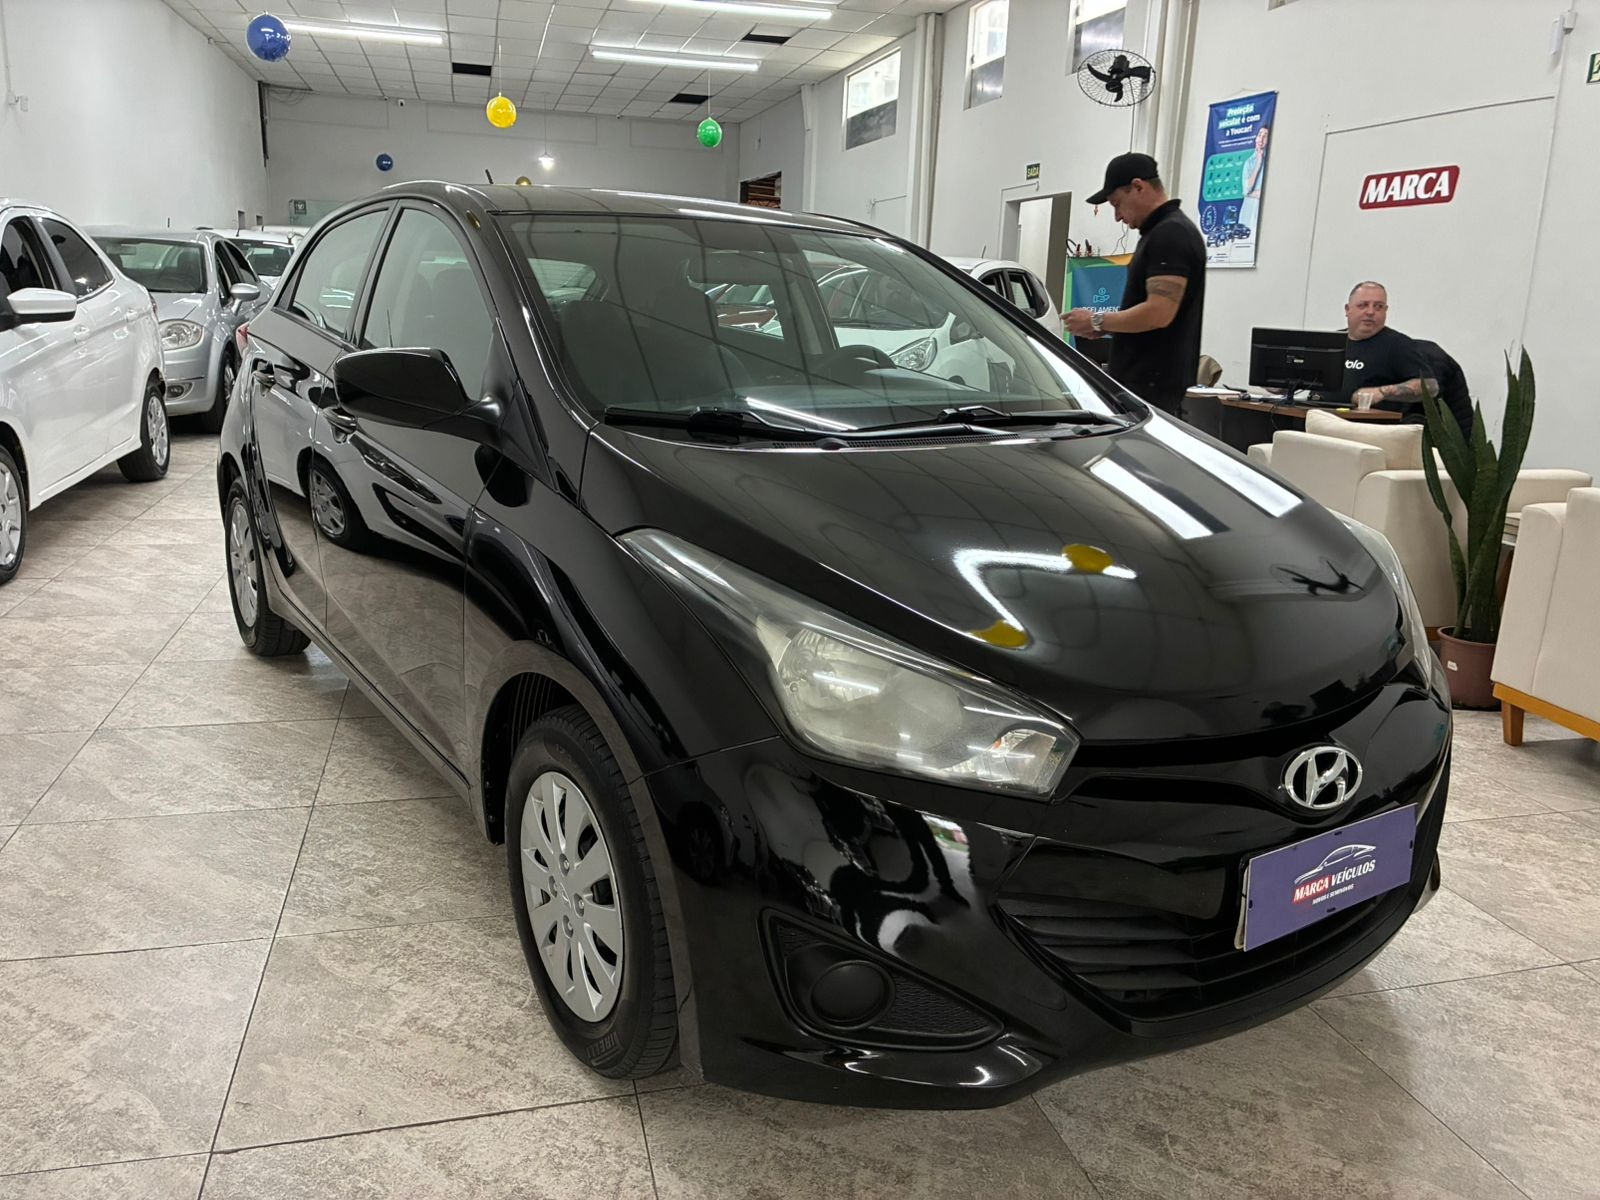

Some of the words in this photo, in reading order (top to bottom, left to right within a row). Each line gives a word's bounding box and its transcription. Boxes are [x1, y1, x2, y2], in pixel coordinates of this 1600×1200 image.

[1246, 113, 1261, 122] com
[1362, 170, 1450, 204] MARCA
[1293, 876, 1329, 903] MARCA
[1331, 860, 1377, 886] VEÍCULOS
